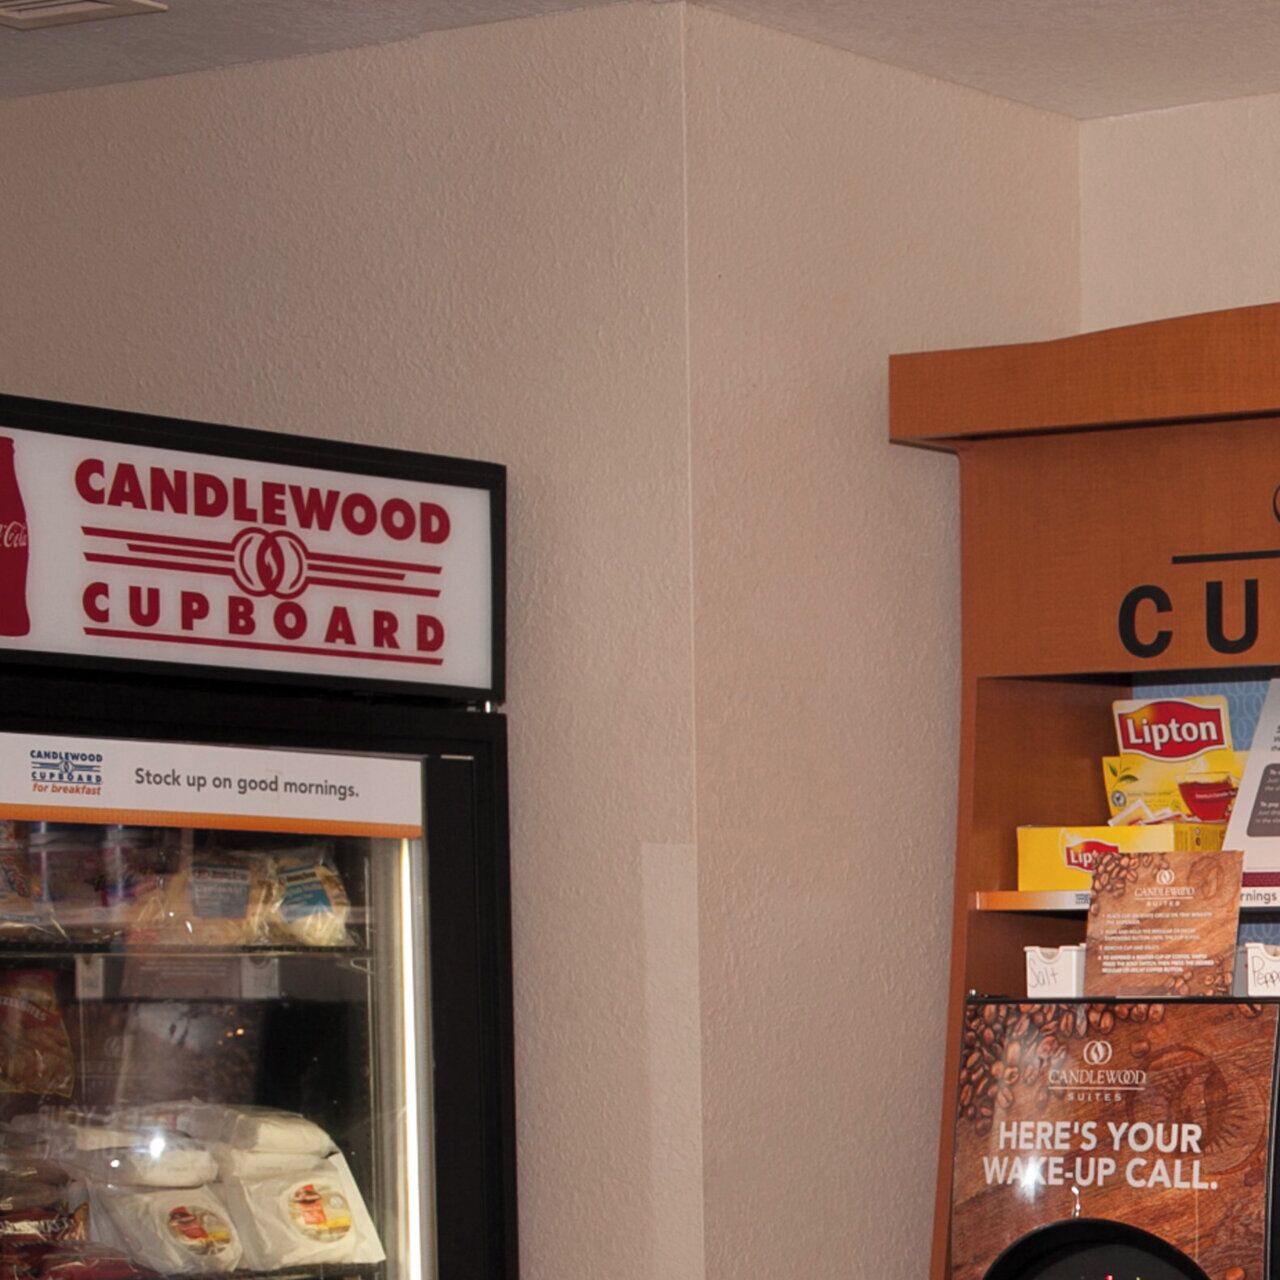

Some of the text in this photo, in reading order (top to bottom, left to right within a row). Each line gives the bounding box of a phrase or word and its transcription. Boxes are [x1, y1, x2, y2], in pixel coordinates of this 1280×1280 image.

[75, 459, 451, 544] CANDLEWOOD
[82, 582, 445, 652] CUPBOARD
[1127, 717, 1219, 754] Lipton
[32, 782, 102, 797] for breakfast
[135, 767, 360, 801] Stock up on good mornings.
[1240, 889, 1278, 905] rnings
[1028, 959, 1058, 989] Salt
[1048, 1068, 1147, 1086] CANDLEWOOD
[1067, 1092, 1122, 1102] SUITES
[999, 1120, 1202, 1154] HERE'S YOUR
[983, 1156, 1218, 1191] WAKE-UP CALL.
